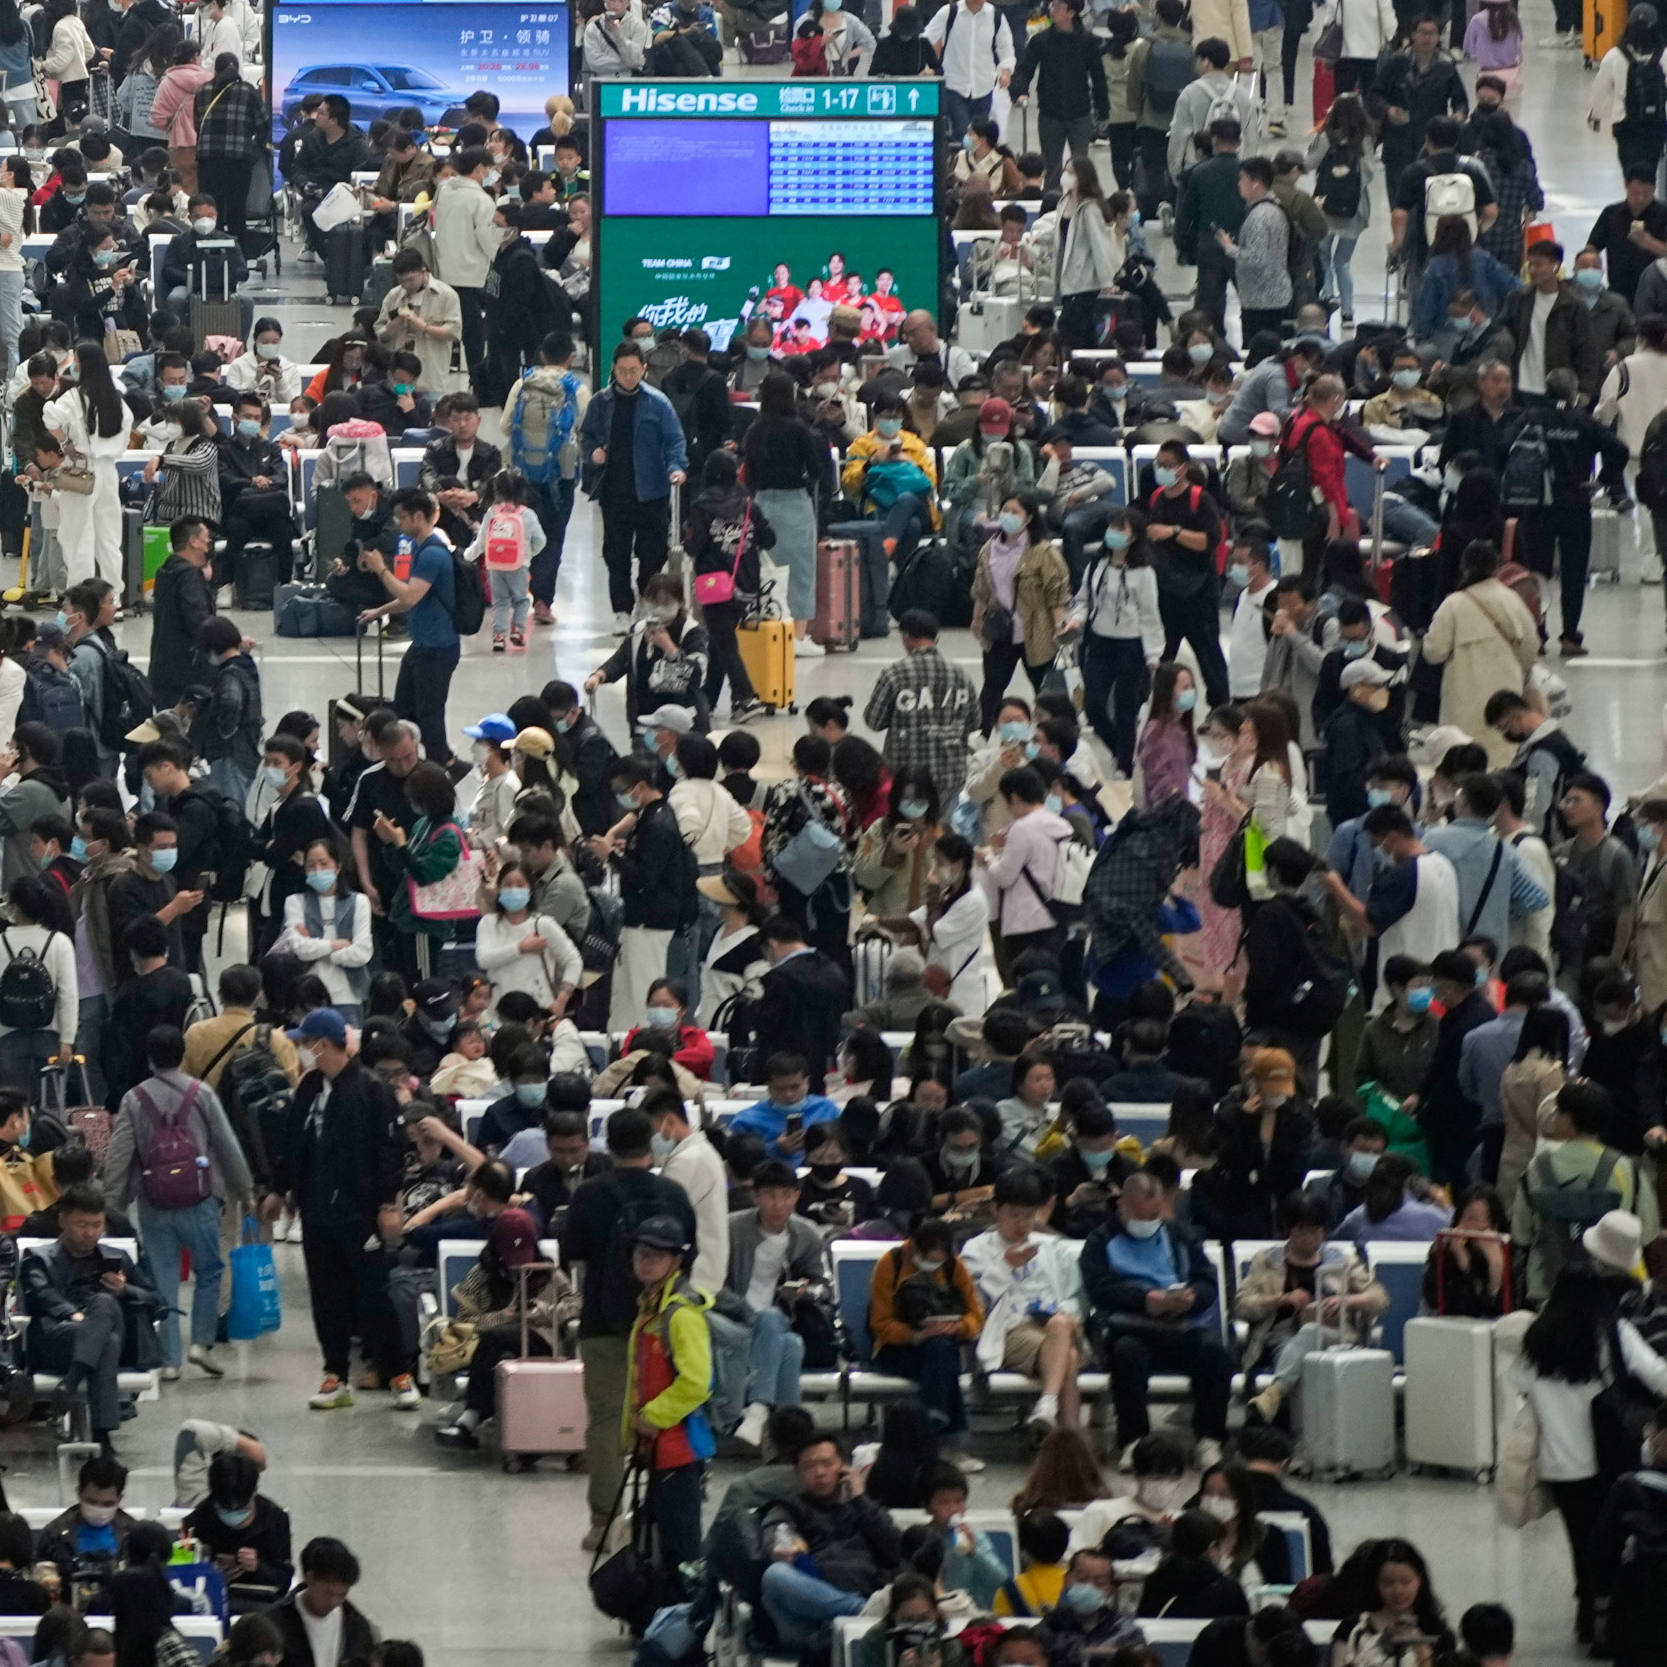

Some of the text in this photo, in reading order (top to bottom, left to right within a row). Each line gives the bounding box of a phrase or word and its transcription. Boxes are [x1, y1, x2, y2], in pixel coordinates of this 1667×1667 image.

[278, 15, 311, 23] BYD
[548, 14, 558, 22] 07
[621, 87, 859, 112] Hisense 检票口 1-17
[642, 259, 692, 268] TEAM CHINA
